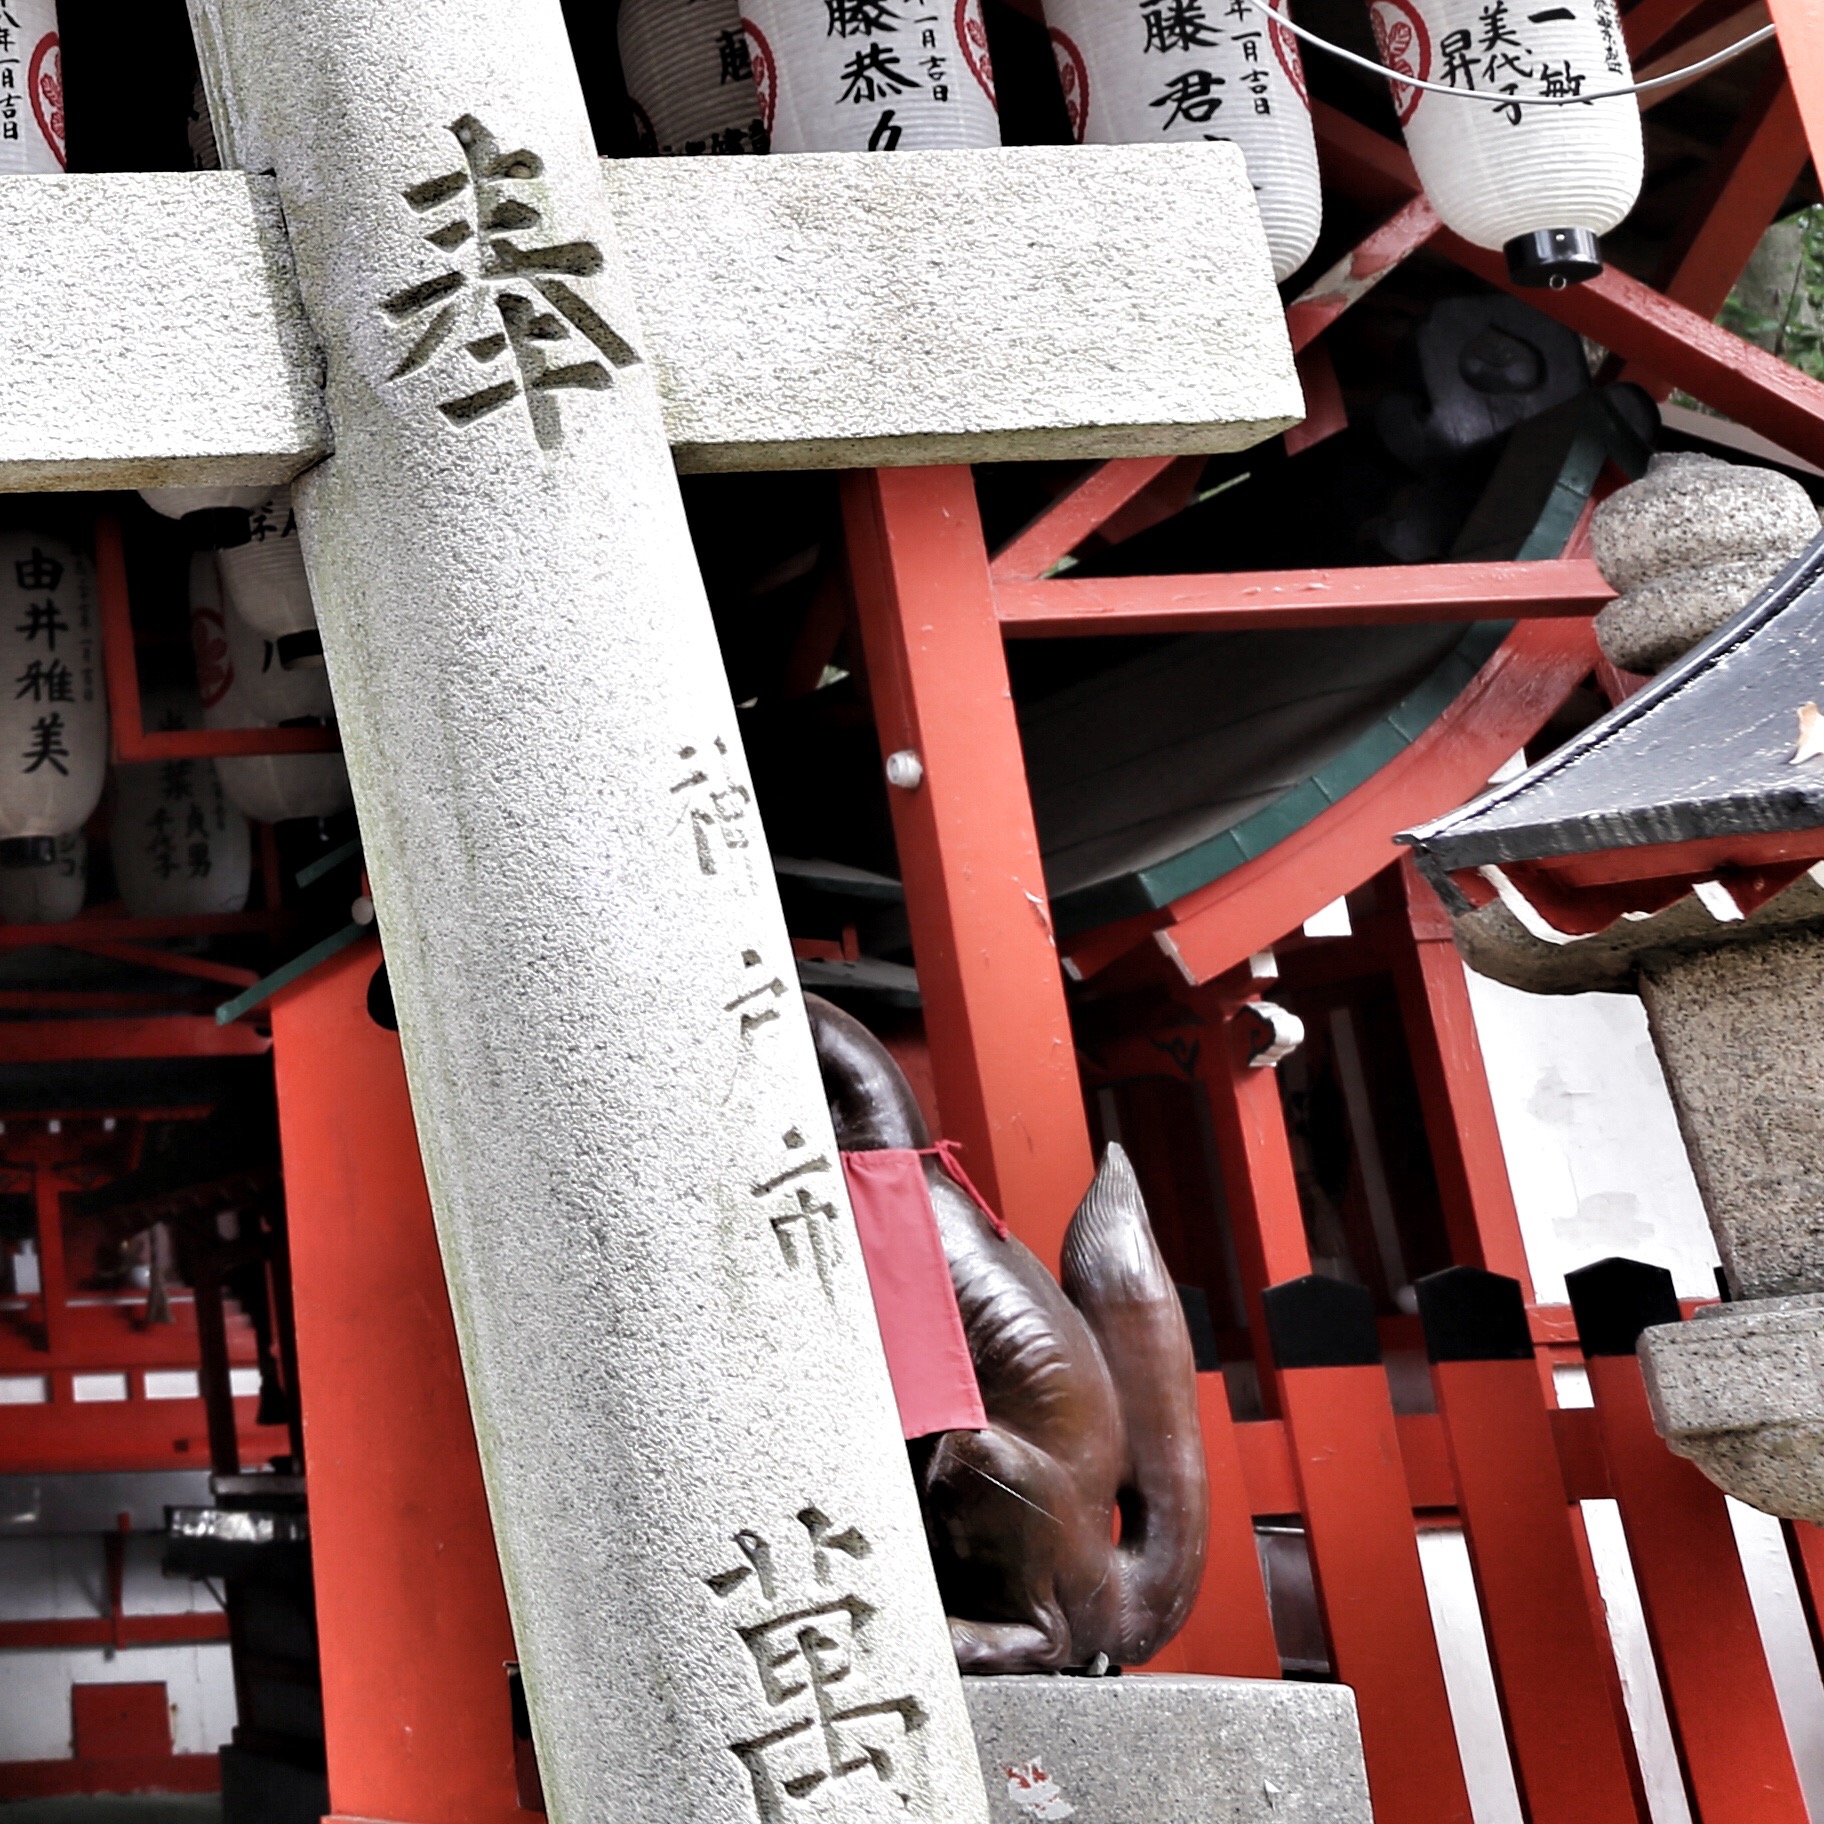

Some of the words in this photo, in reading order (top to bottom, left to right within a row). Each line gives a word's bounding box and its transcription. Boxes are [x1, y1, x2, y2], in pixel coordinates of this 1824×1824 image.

[377, 110, 644, 453] 奉
[13, 546, 76, 777] 由井雅美
